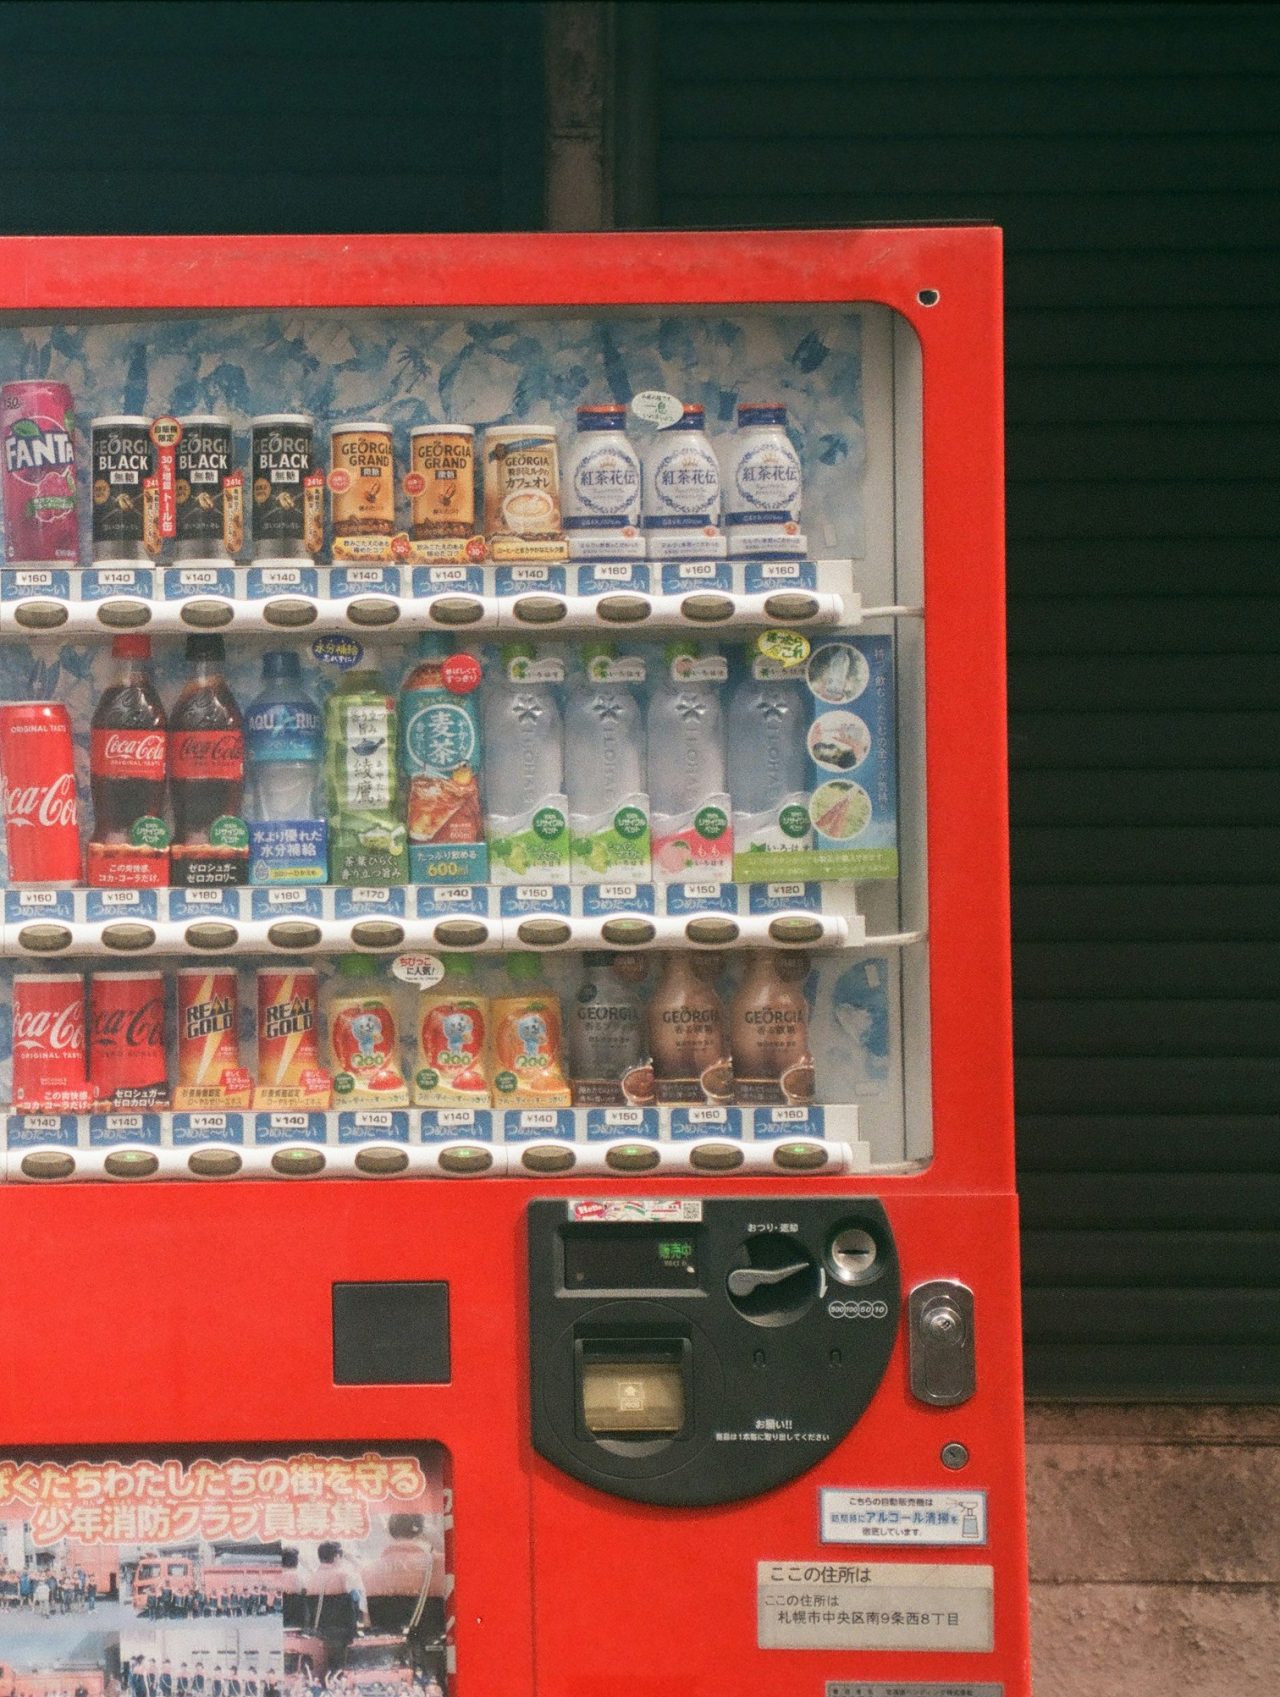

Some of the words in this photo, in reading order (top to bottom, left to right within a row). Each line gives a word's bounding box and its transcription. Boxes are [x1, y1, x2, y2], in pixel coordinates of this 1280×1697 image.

[158, 434, 174, 442] 限定
[5, 432, 75, 471] FANTA
[418, 444, 471, 458] GEORGIA
[99, 455, 148, 470] BLACK
[180, 455, 228, 469] BLACK
[260, 454, 309, 469] BLACK
[349, 456, 390, 466] GRAND
[424, 457, 467, 469] GRAND
[505, 456, 549, 466] GEORGIA
[112, 472, 137, 483] 無糖
[191, 471, 216, 482] 無糖
[273, 471, 297, 482] 無糖
[580, 470, 636, 486] 紅茶花伝
[662, 470, 717, 485] 紅茶花伝
[743, 466, 798, 481] 紅茶花伝
[145, 479, 158, 487] 241
[505, 477, 550, 489] カフェオレ
[105, 574, 130, 582] ¥140
[186, 574, 211, 582] ¥140
[271, 574, 296, 582] ¥140
[353, 572, 378, 580] ¥140
[436, 570, 462, 579] ¥140
[518, 570, 544, 578] ¥140
[11, 725, 49, 733] ORIGINAL
[429, 711, 456, 765] 麦茶
[105, 734, 166, 760] Coca-Cola
[254, 829, 322, 842] 水より優れた
[261, 845, 316, 857] 水分補給
[188, 863, 237, 873] ゼロシュガー
[342, 868, 401, 880] 香り立つ旨み
[359, 890, 384, 898] ¥170
[441, 889, 469, 898] ¥140
[400, 957, 431, 966] ちびっこ
[186, 993, 232, 1022] REAL
[266, 993, 312, 1022] REAL
[187, 1014, 232, 1040] GOLD
[267, 1014, 312, 1040] GOLD
[115, 1089, 166, 1099] ゼロシュガー
[30, 1119, 56, 1127] ¥140
[112, 1118, 138, 1126] ¥140
[527, 1115, 552, 1123] ¥140
[747, 1223, 799, 1233] おつり・返却
[659, 1242, 692, 1258] 販売中
[755, 1420, 793, 1430] お願い!!
[849, 1498, 933, 1507] こちらの自動販売機は
[37, 1500, 365, 1540] 少年消防クラブ員募集
[831, 1511, 959, 1525] 訪問時にアルコール清掃を
[771, 1566, 872, 1583] ここの住所は
[765, 1594, 840, 1607] ここの住所は
[778, 1611, 960, 1626] 札幌市中央区南9条西8丁目
